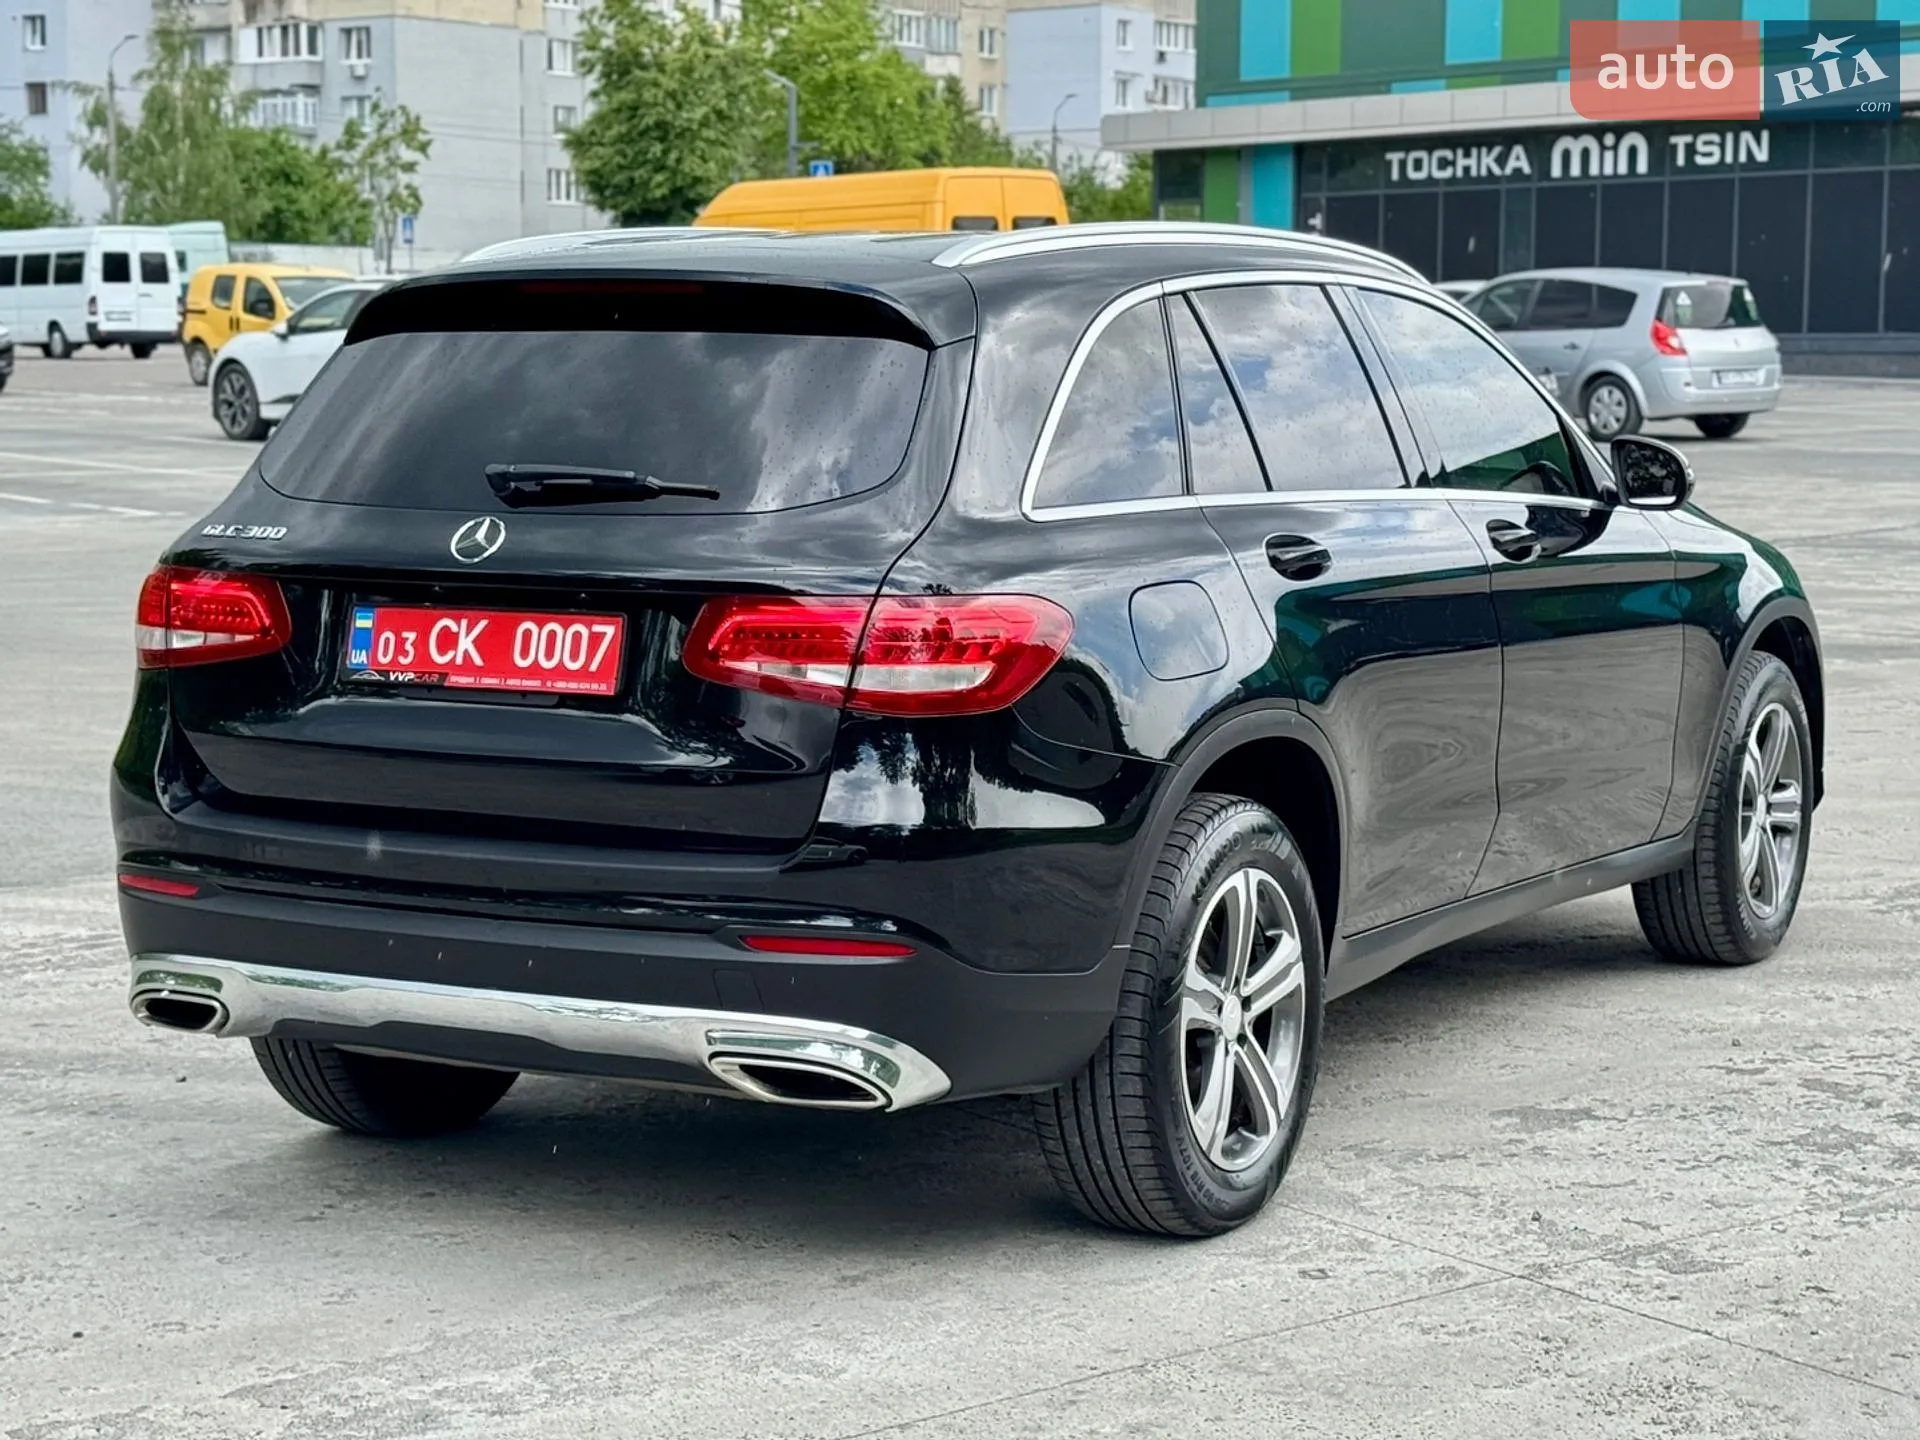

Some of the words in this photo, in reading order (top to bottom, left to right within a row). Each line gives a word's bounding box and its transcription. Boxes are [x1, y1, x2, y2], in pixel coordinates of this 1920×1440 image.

[1385, 144, 1532, 181] TOCHKA
[1669, 129, 1770, 167] TSIN
[201, 524, 243, 539] GLC
[240, 525, 288, 541] 300
[351, 649, 368, 664] UA
[377, 630, 417, 665] 03
[428, 617, 489, 667] CK
[513, 621, 616, 672] 0007
